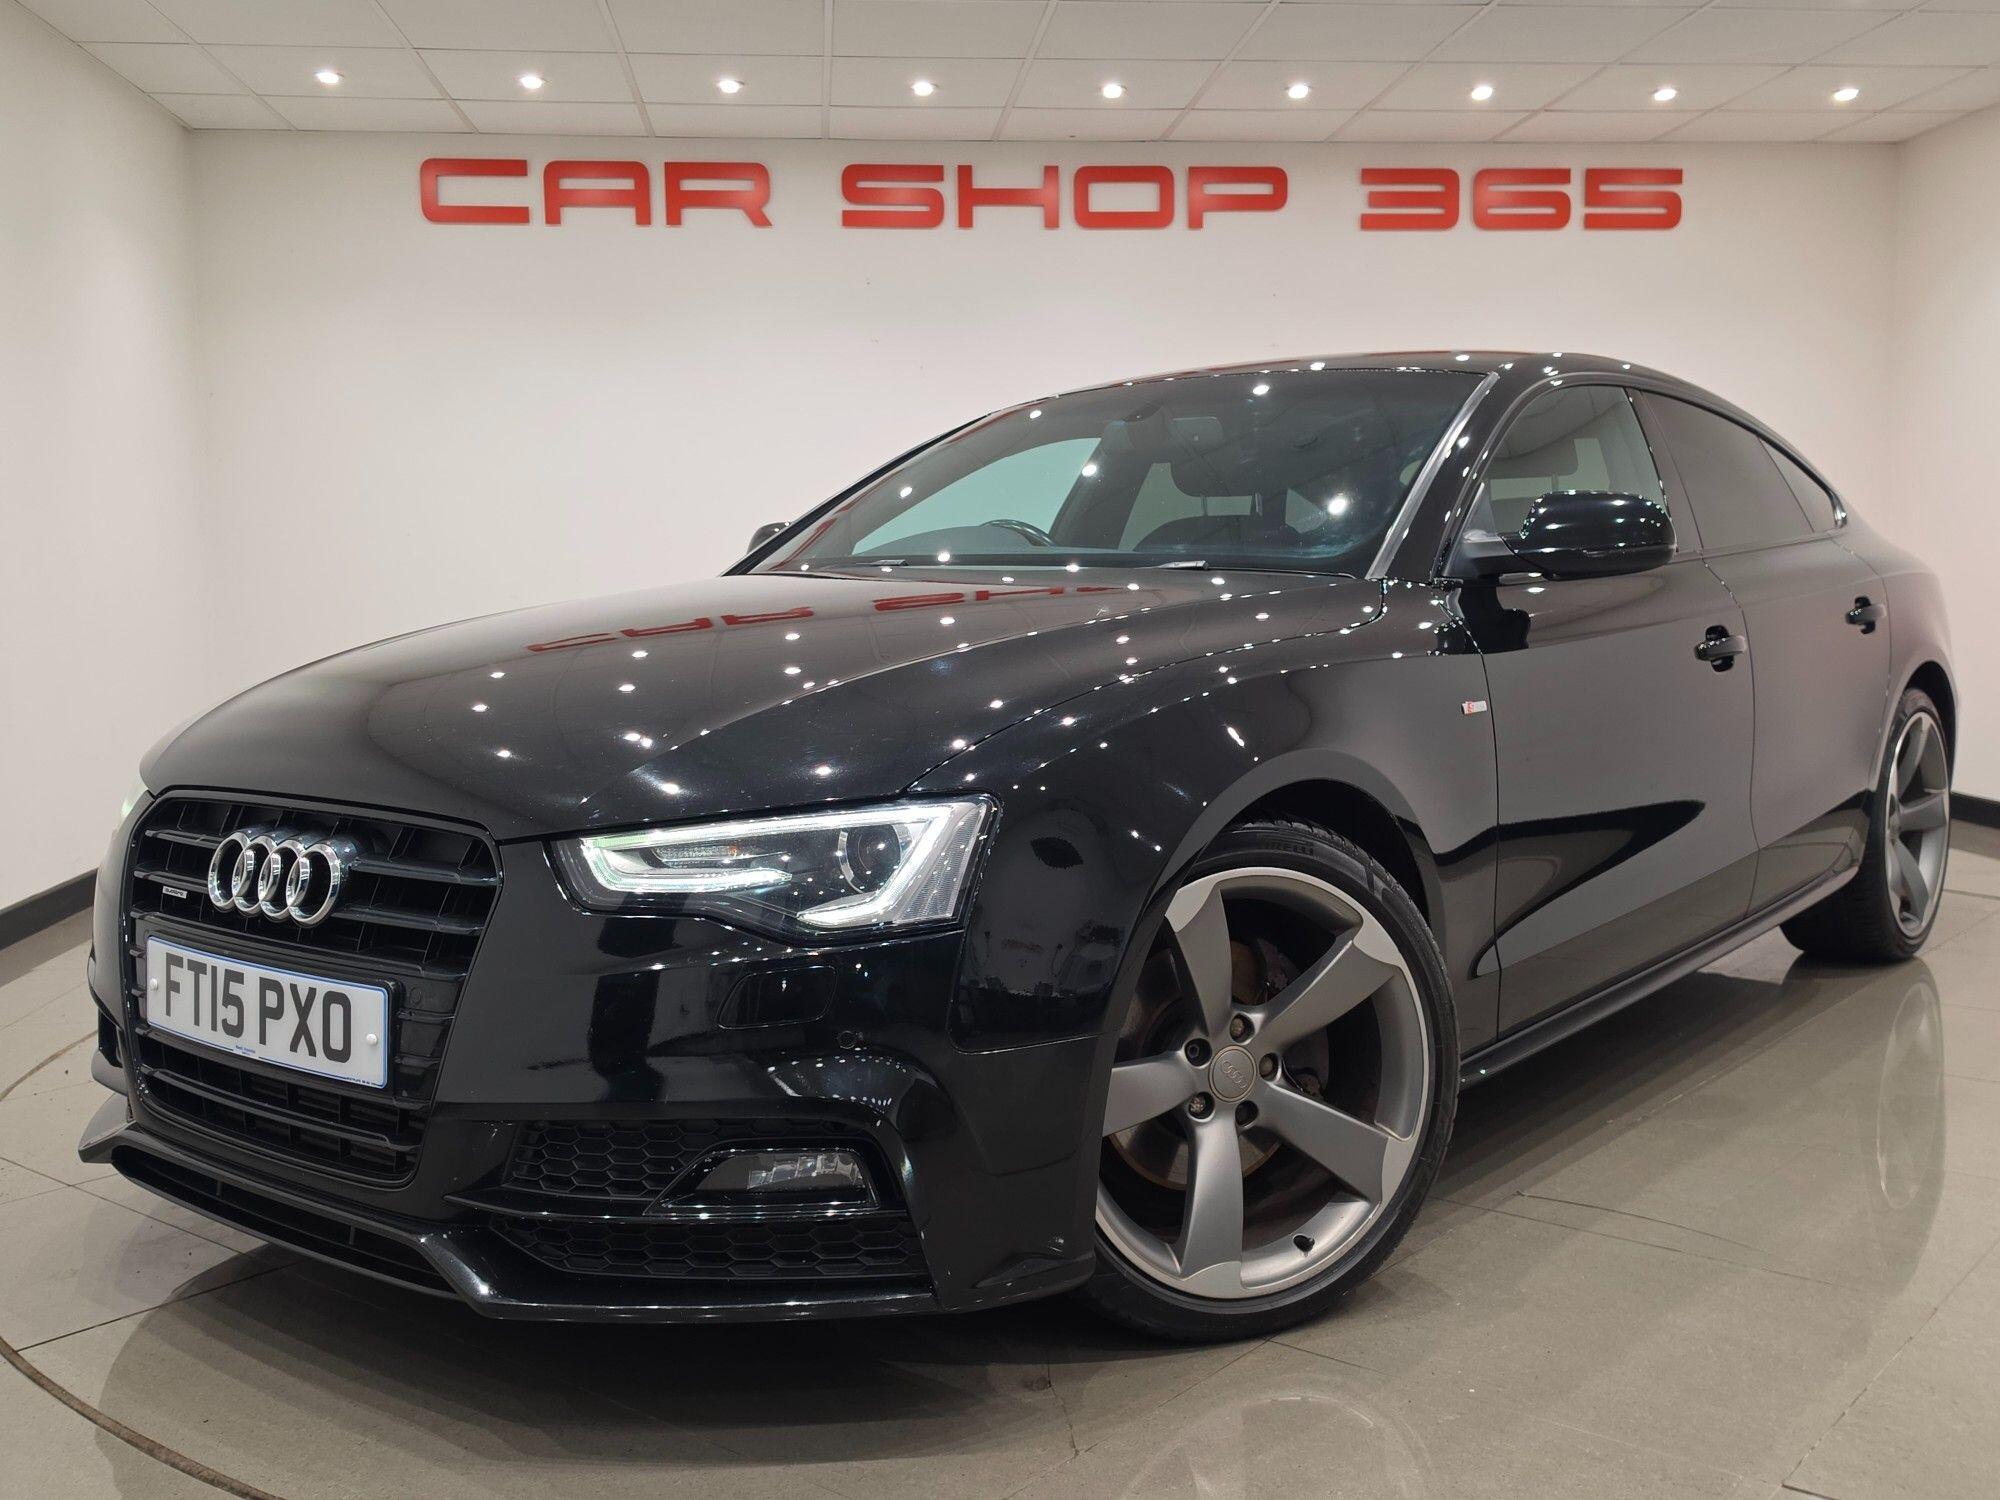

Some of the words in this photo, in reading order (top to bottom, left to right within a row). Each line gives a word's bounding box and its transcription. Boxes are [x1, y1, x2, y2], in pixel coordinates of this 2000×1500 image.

[420, 158, 771, 228] CAR
[841, 163, 1289, 230] SHOP
[1360, 167, 1684, 231] 365
[165, 952, 245, 1039] FT15
[259, 976, 352, 1065] PXO
